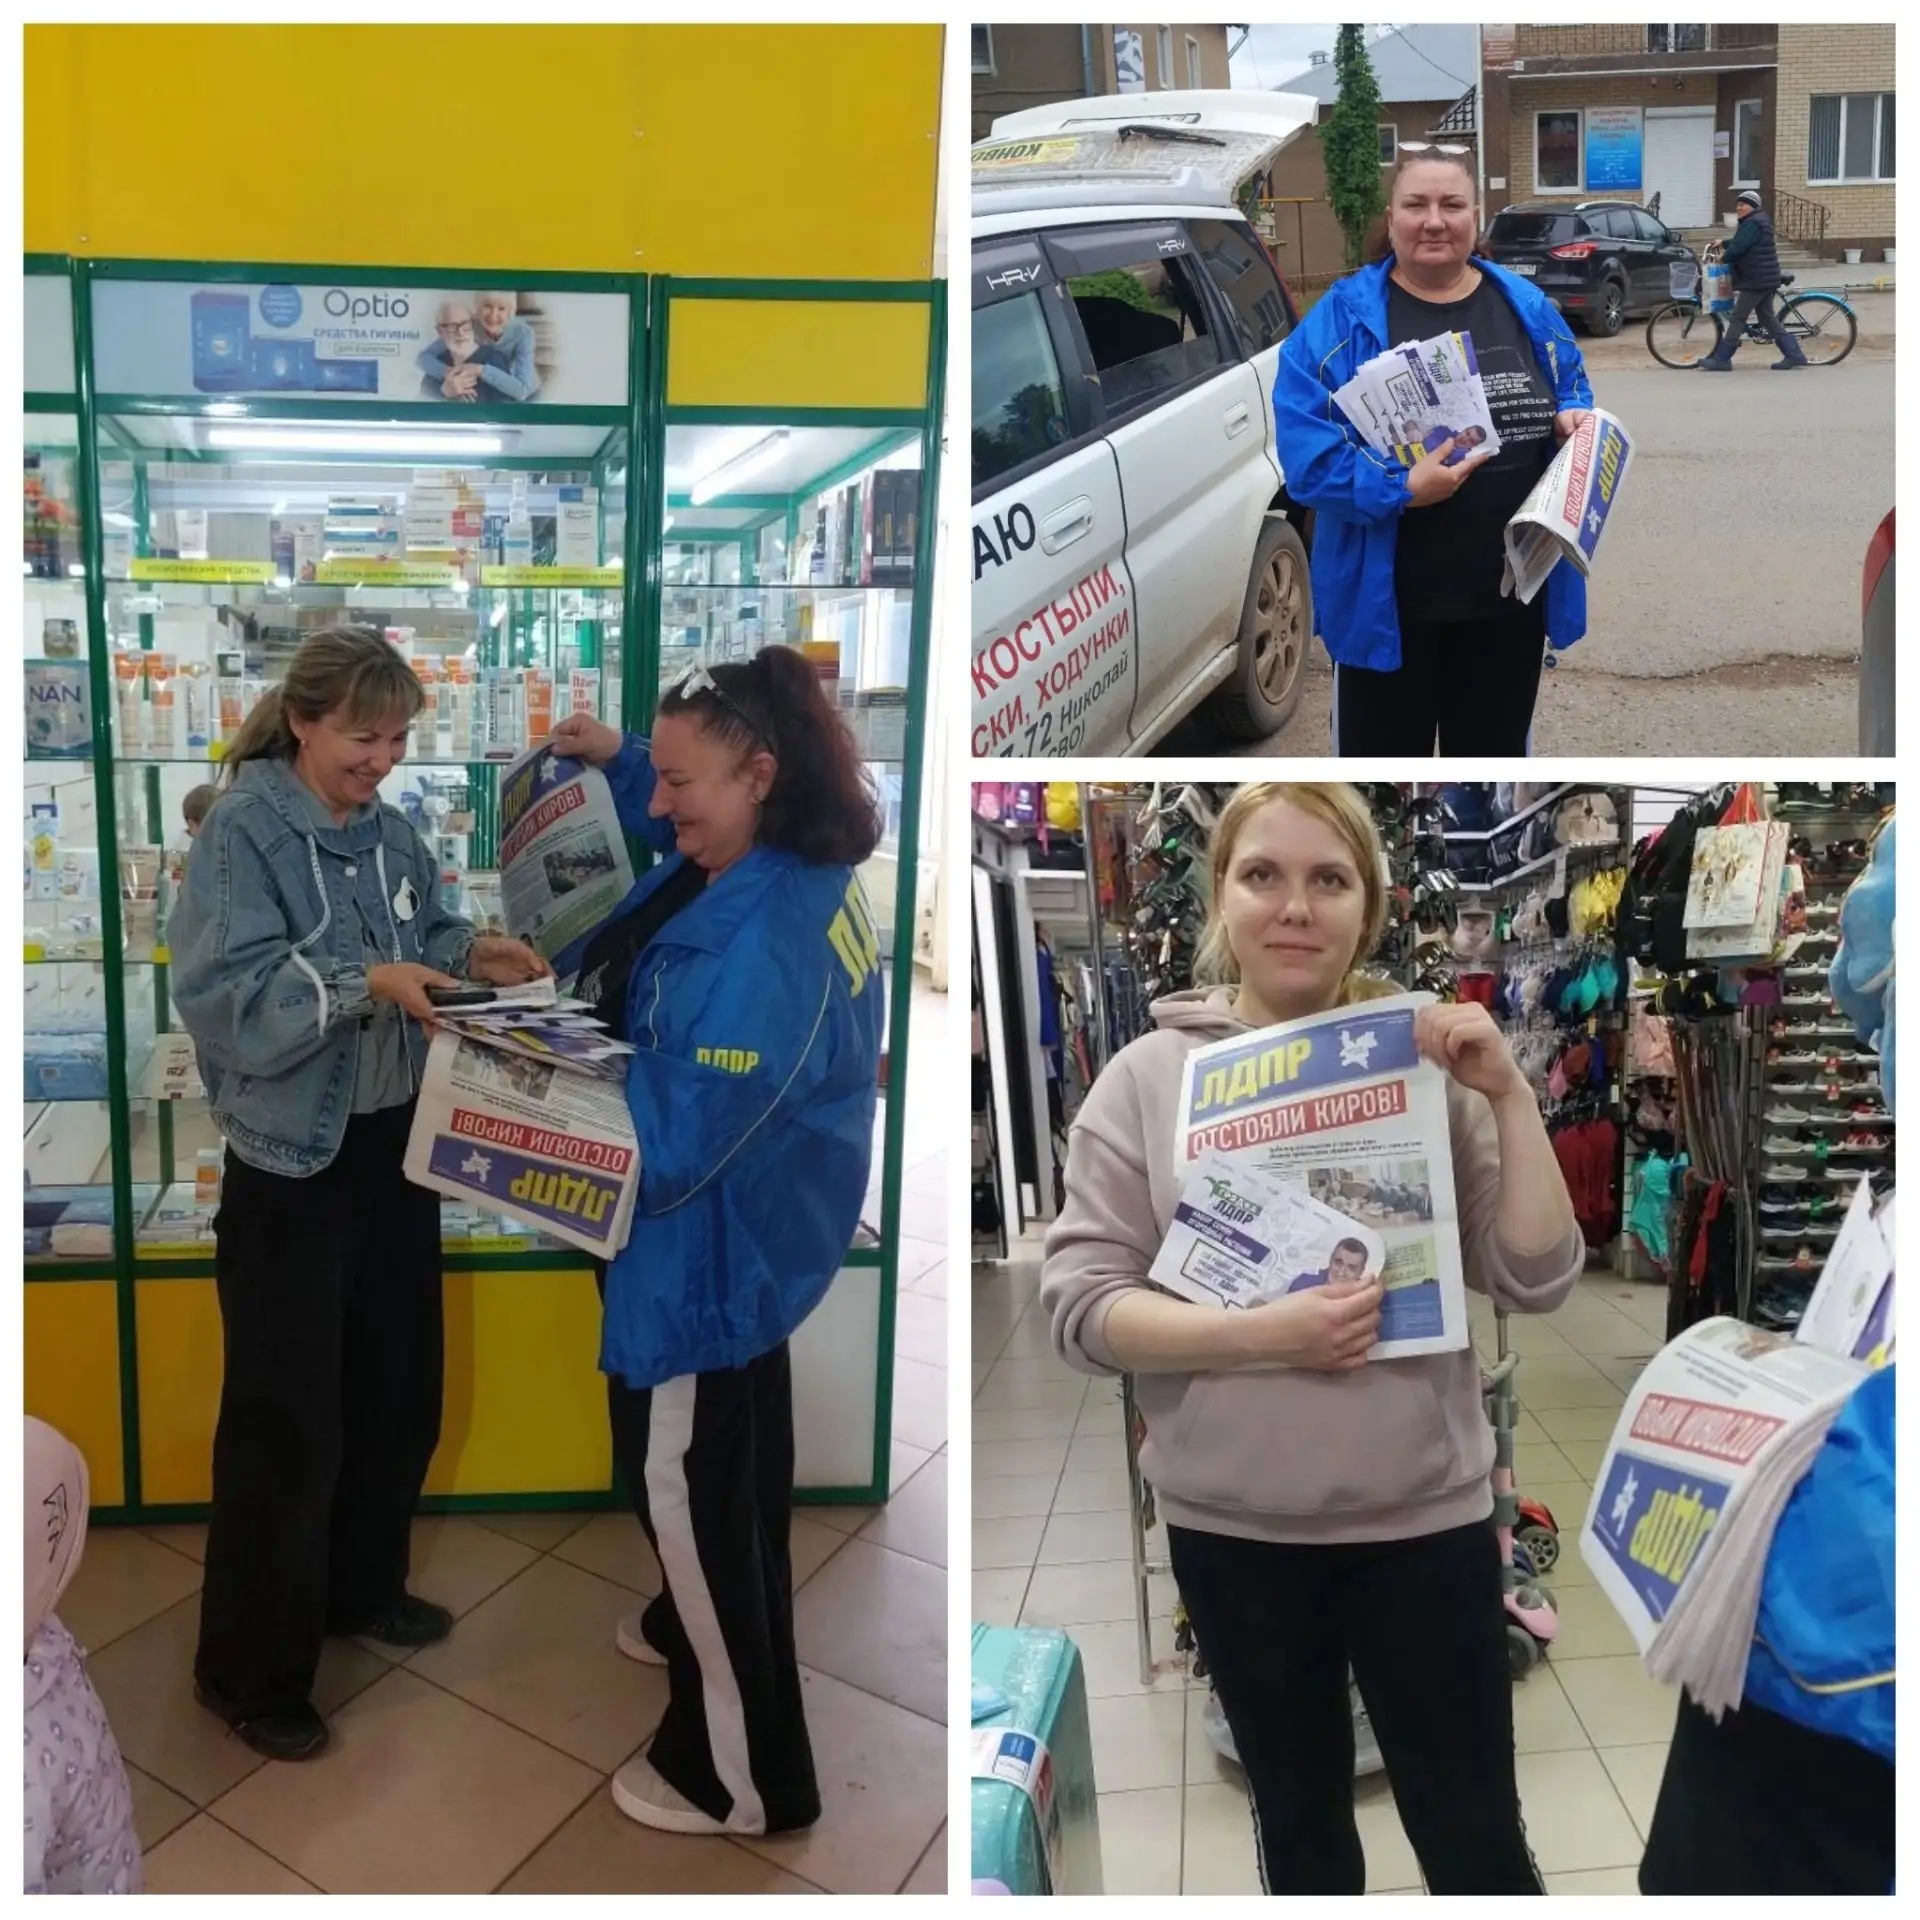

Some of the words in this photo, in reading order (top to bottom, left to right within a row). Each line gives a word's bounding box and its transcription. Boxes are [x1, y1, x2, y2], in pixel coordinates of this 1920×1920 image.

[313, 328, 368, 340] СРЕДСТВА
[369, 329, 421, 340] ГИГИЕНЫ
[323, 288, 411, 325] Optio
[1598, 425, 1623, 504] ЛДПР
[971, 562, 1127, 700] КОСТЫЛИ,
[1035, 607, 1130, 711] ХОДУНКИ
[29, 684, 81, 704] NAN
[1059, 651, 1129, 733] Николай
[1193, 1036, 1313, 1112] ЛДПР
[455, 1110, 525, 1146] КИРОВ!
[1193, 1106, 1307, 1156] ОТСТОЯЛИ
[1314, 1083, 1401, 1129] КИРОВ!
[529, 1127, 627, 1172] ОТСТОЯЛИ
[509, 1167, 617, 1223] ЛДПР
[1212, 1199, 1255, 1225] ЛДПР
